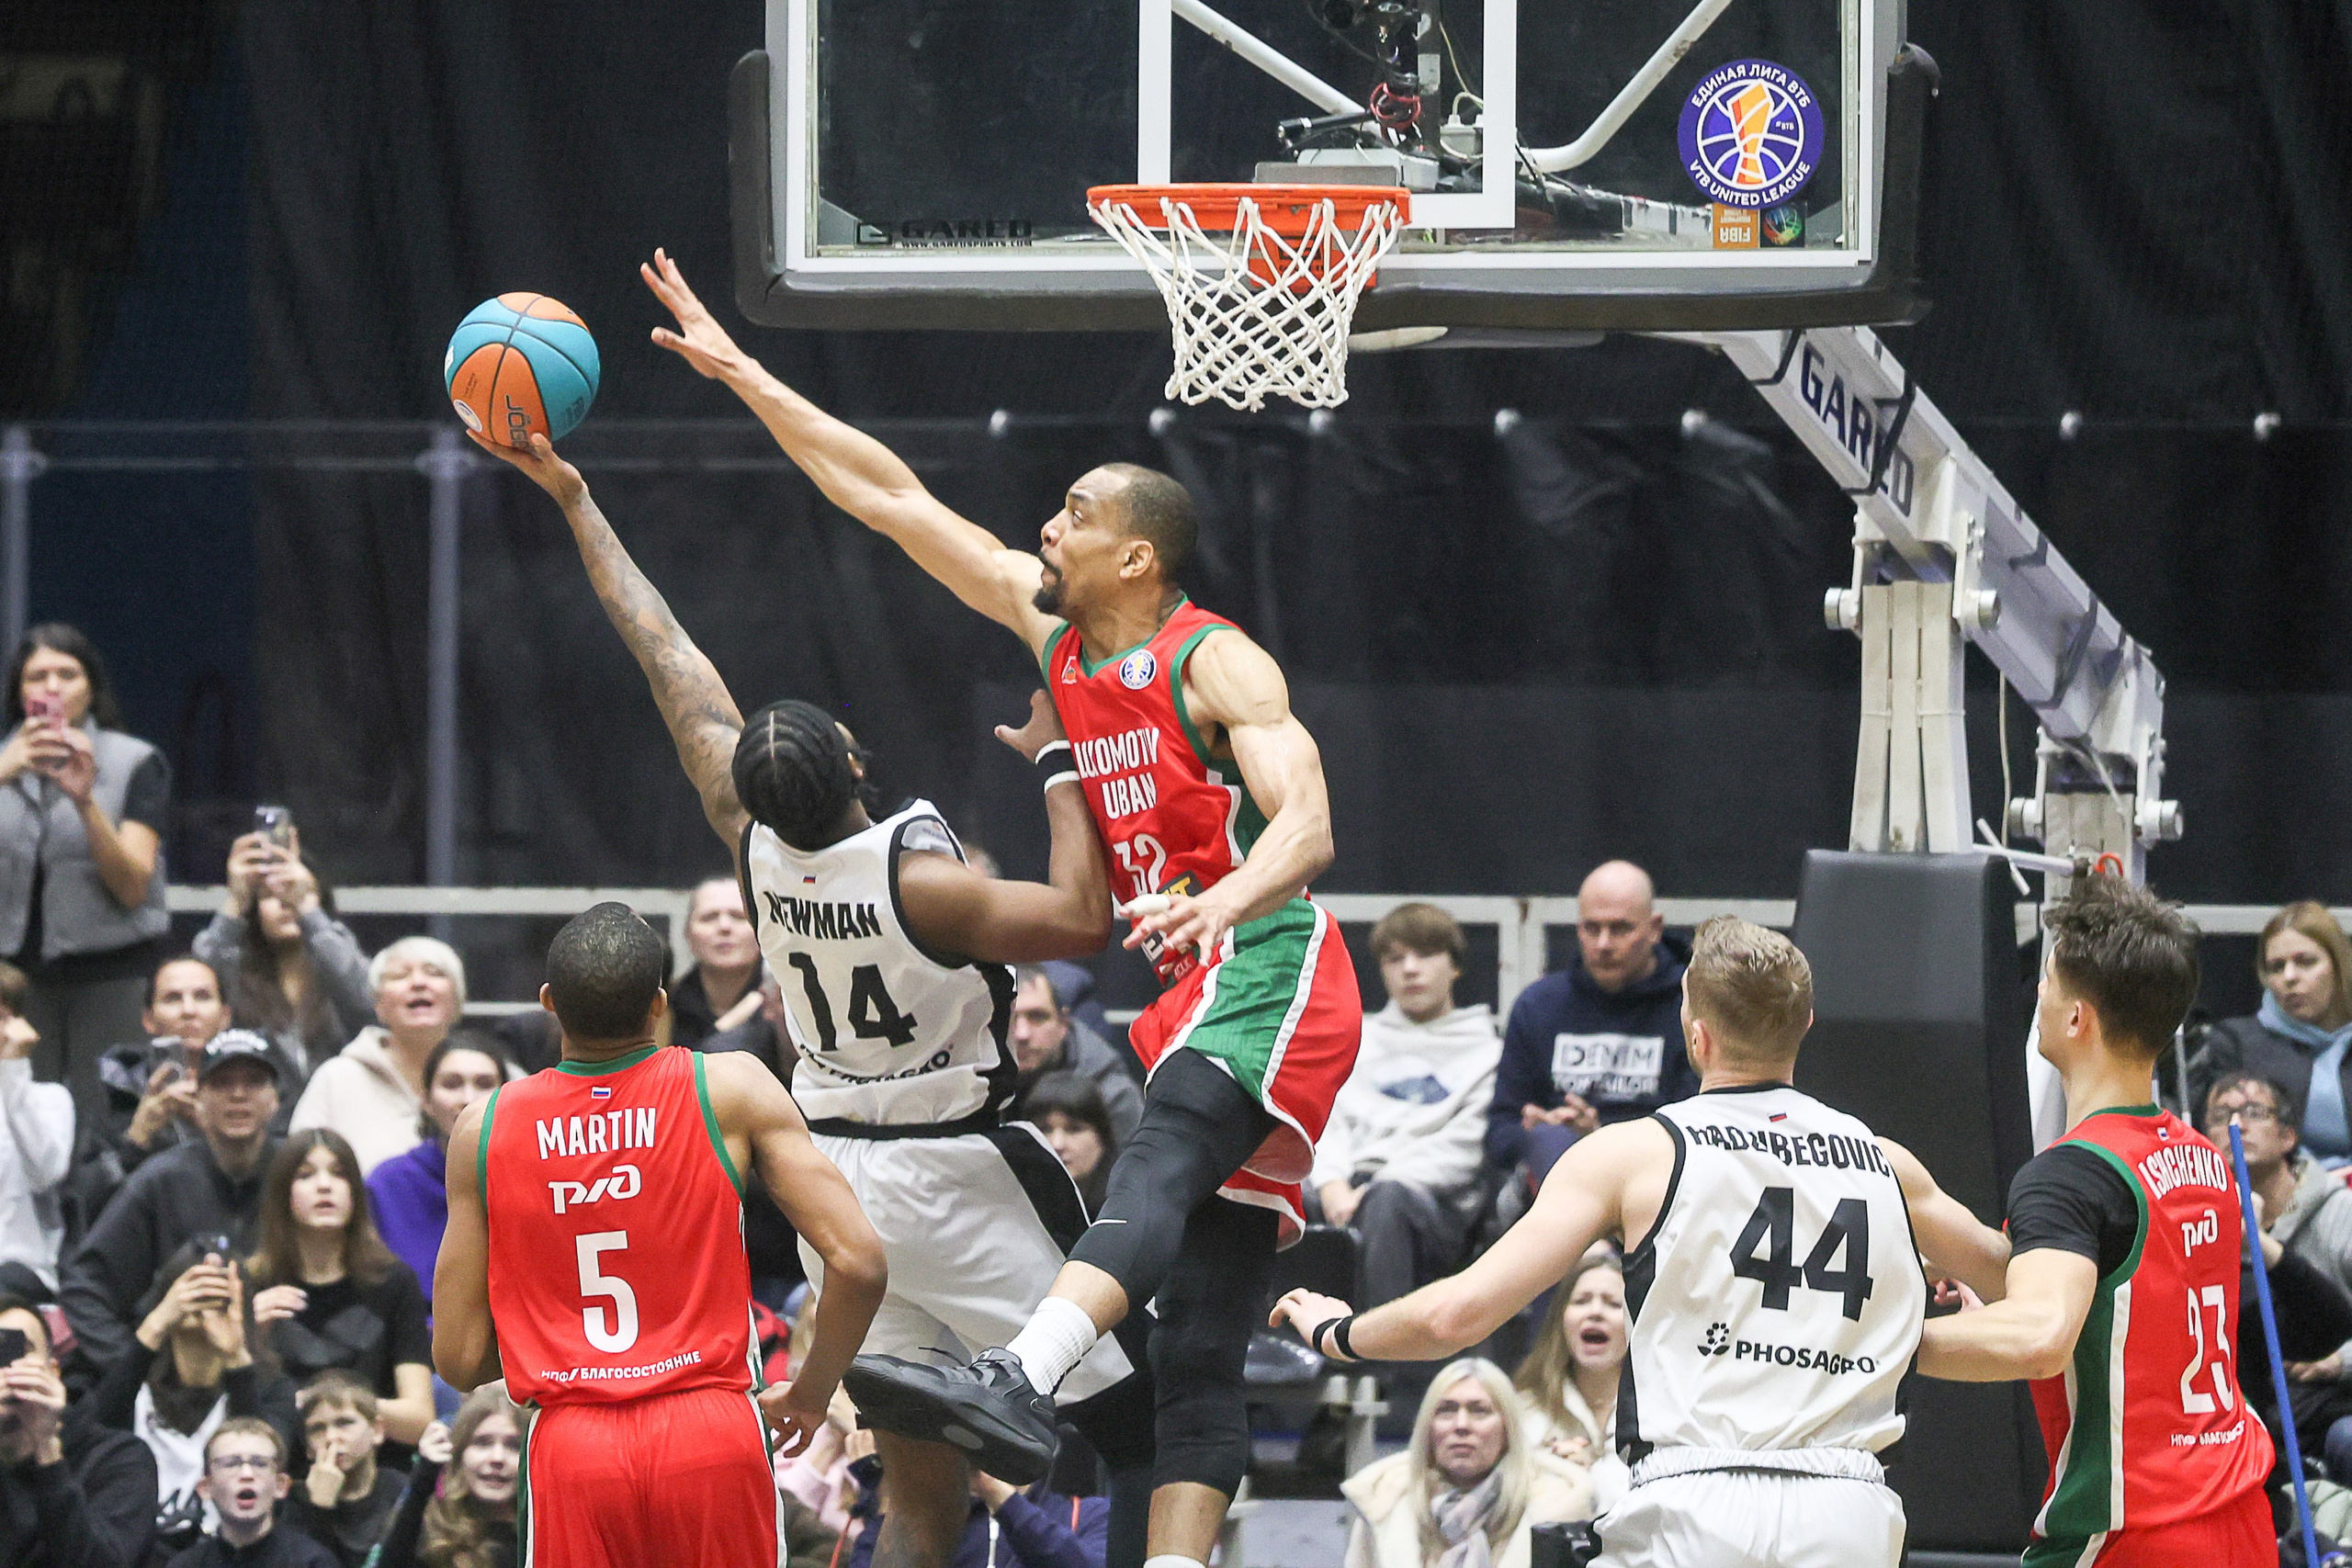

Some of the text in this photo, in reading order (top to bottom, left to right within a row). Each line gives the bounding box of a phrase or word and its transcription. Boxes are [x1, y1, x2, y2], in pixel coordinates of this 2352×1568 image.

[1691, 64, 1811, 108] ЕДИНАЯ ЛИГА ВТБ
[1689, 160, 1811, 206] VTB UNITED LEAGUE
[1720, 227, 1751, 243] FIBA
[1801, 341, 1915, 518] GARD
[1102, 772, 1158, 819] UBAN
[763, 890, 883, 940] NEWMAN
[788, 952, 918, 1052] 14
[536, 1107, 656, 1160] MARTIN
[2137, 1145, 2228, 1201] ISHCHENKO
[1729, 1186, 1873, 1323] 44
[575, 1230, 639, 1353] 5
[581, 1350, 702, 1380] БЛАГОСОСТОЯНИЕ
[1735, 1338, 1876, 1375] PHOSAGRO
[2180, 1284, 2234, 1415] 23
